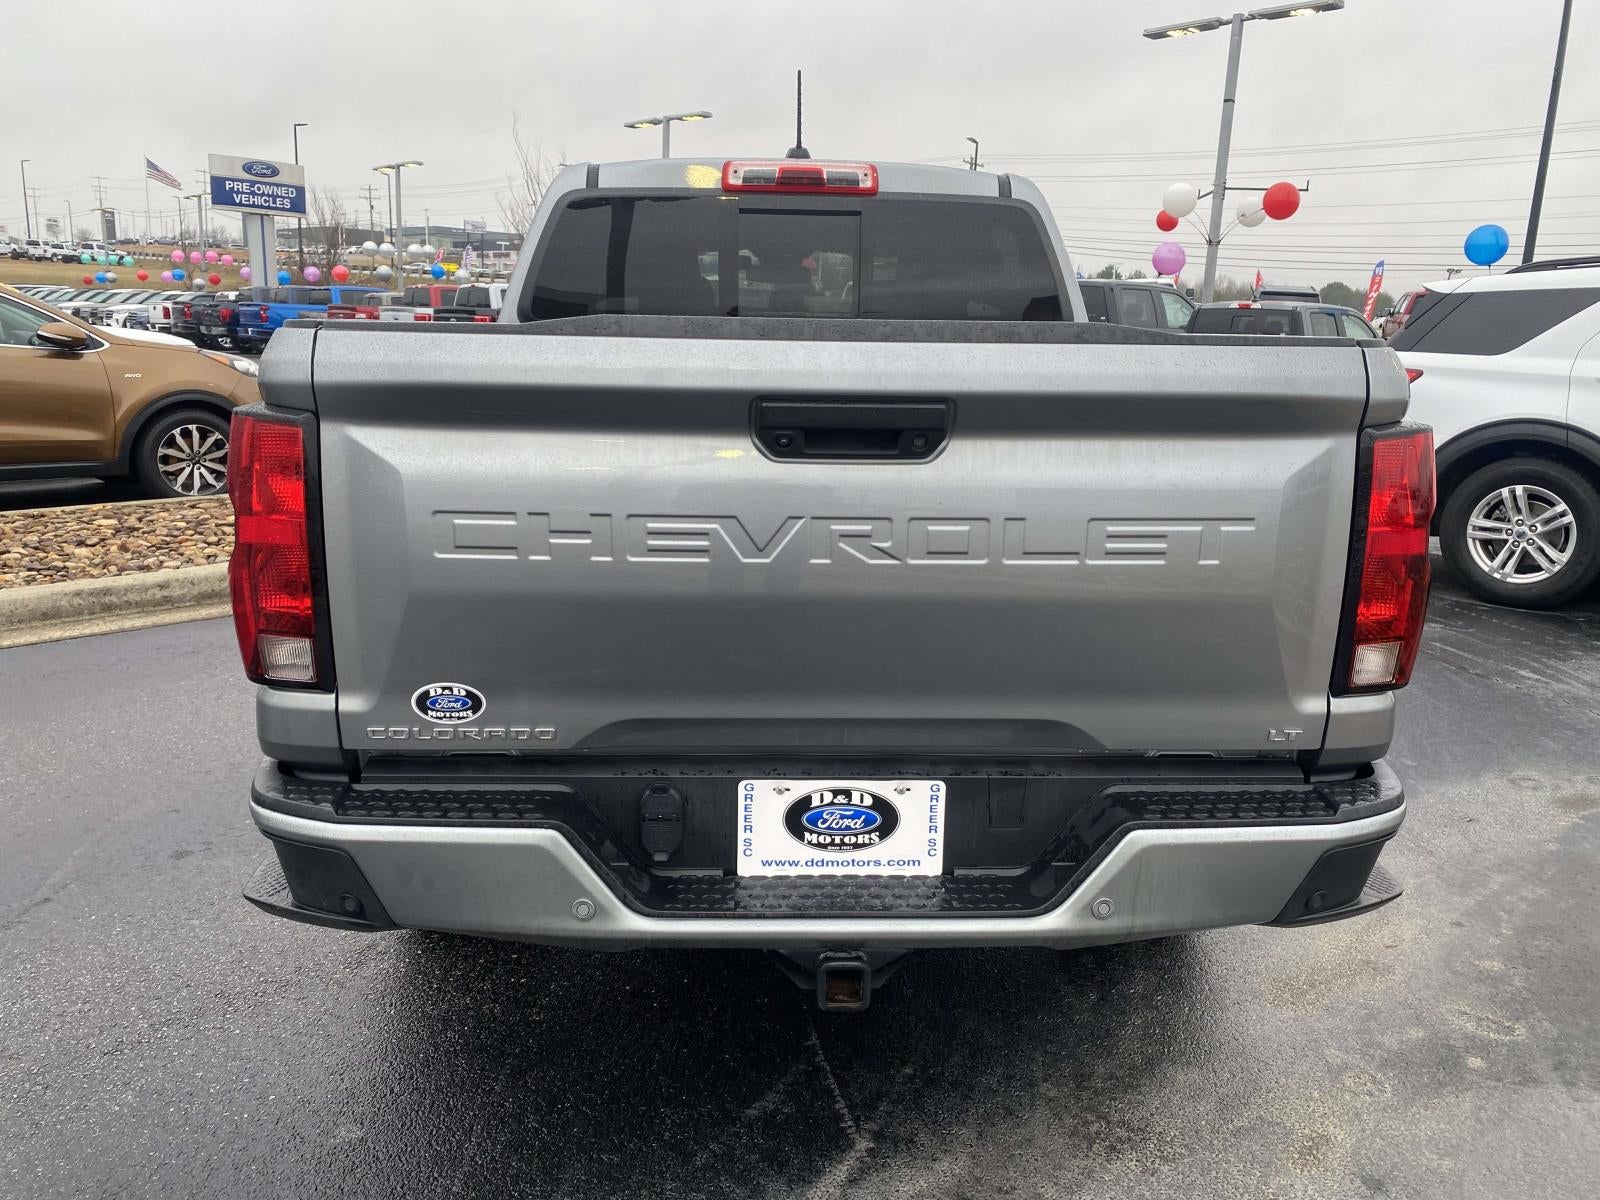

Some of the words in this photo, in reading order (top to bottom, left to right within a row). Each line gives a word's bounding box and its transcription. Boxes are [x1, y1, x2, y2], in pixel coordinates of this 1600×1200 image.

[251, 164, 272, 175] Ford
[225, 181, 296, 198] PRE-OWNED
[233, 193, 291, 208] VEHICLES
[432, 510, 1256, 565] CHEVROLET
[429, 687, 467, 697] D&D
[435, 697, 462, 708] Ford
[427, 710, 473, 718] MOTORS
[366, 727, 557, 740] COLORADO
[1268, 729, 1304, 741] LT
[810, 791, 873, 807] D&D
[743, 783, 755, 833] GREER
[929, 784, 941, 833] GREER
[817, 809, 865, 829] Ford
[804, 831, 880, 844] MOTORS
[743, 838, 753, 857] SC
[927, 838, 938, 857] SC
[760, 857, 921, 867] www.ddmotors.com
